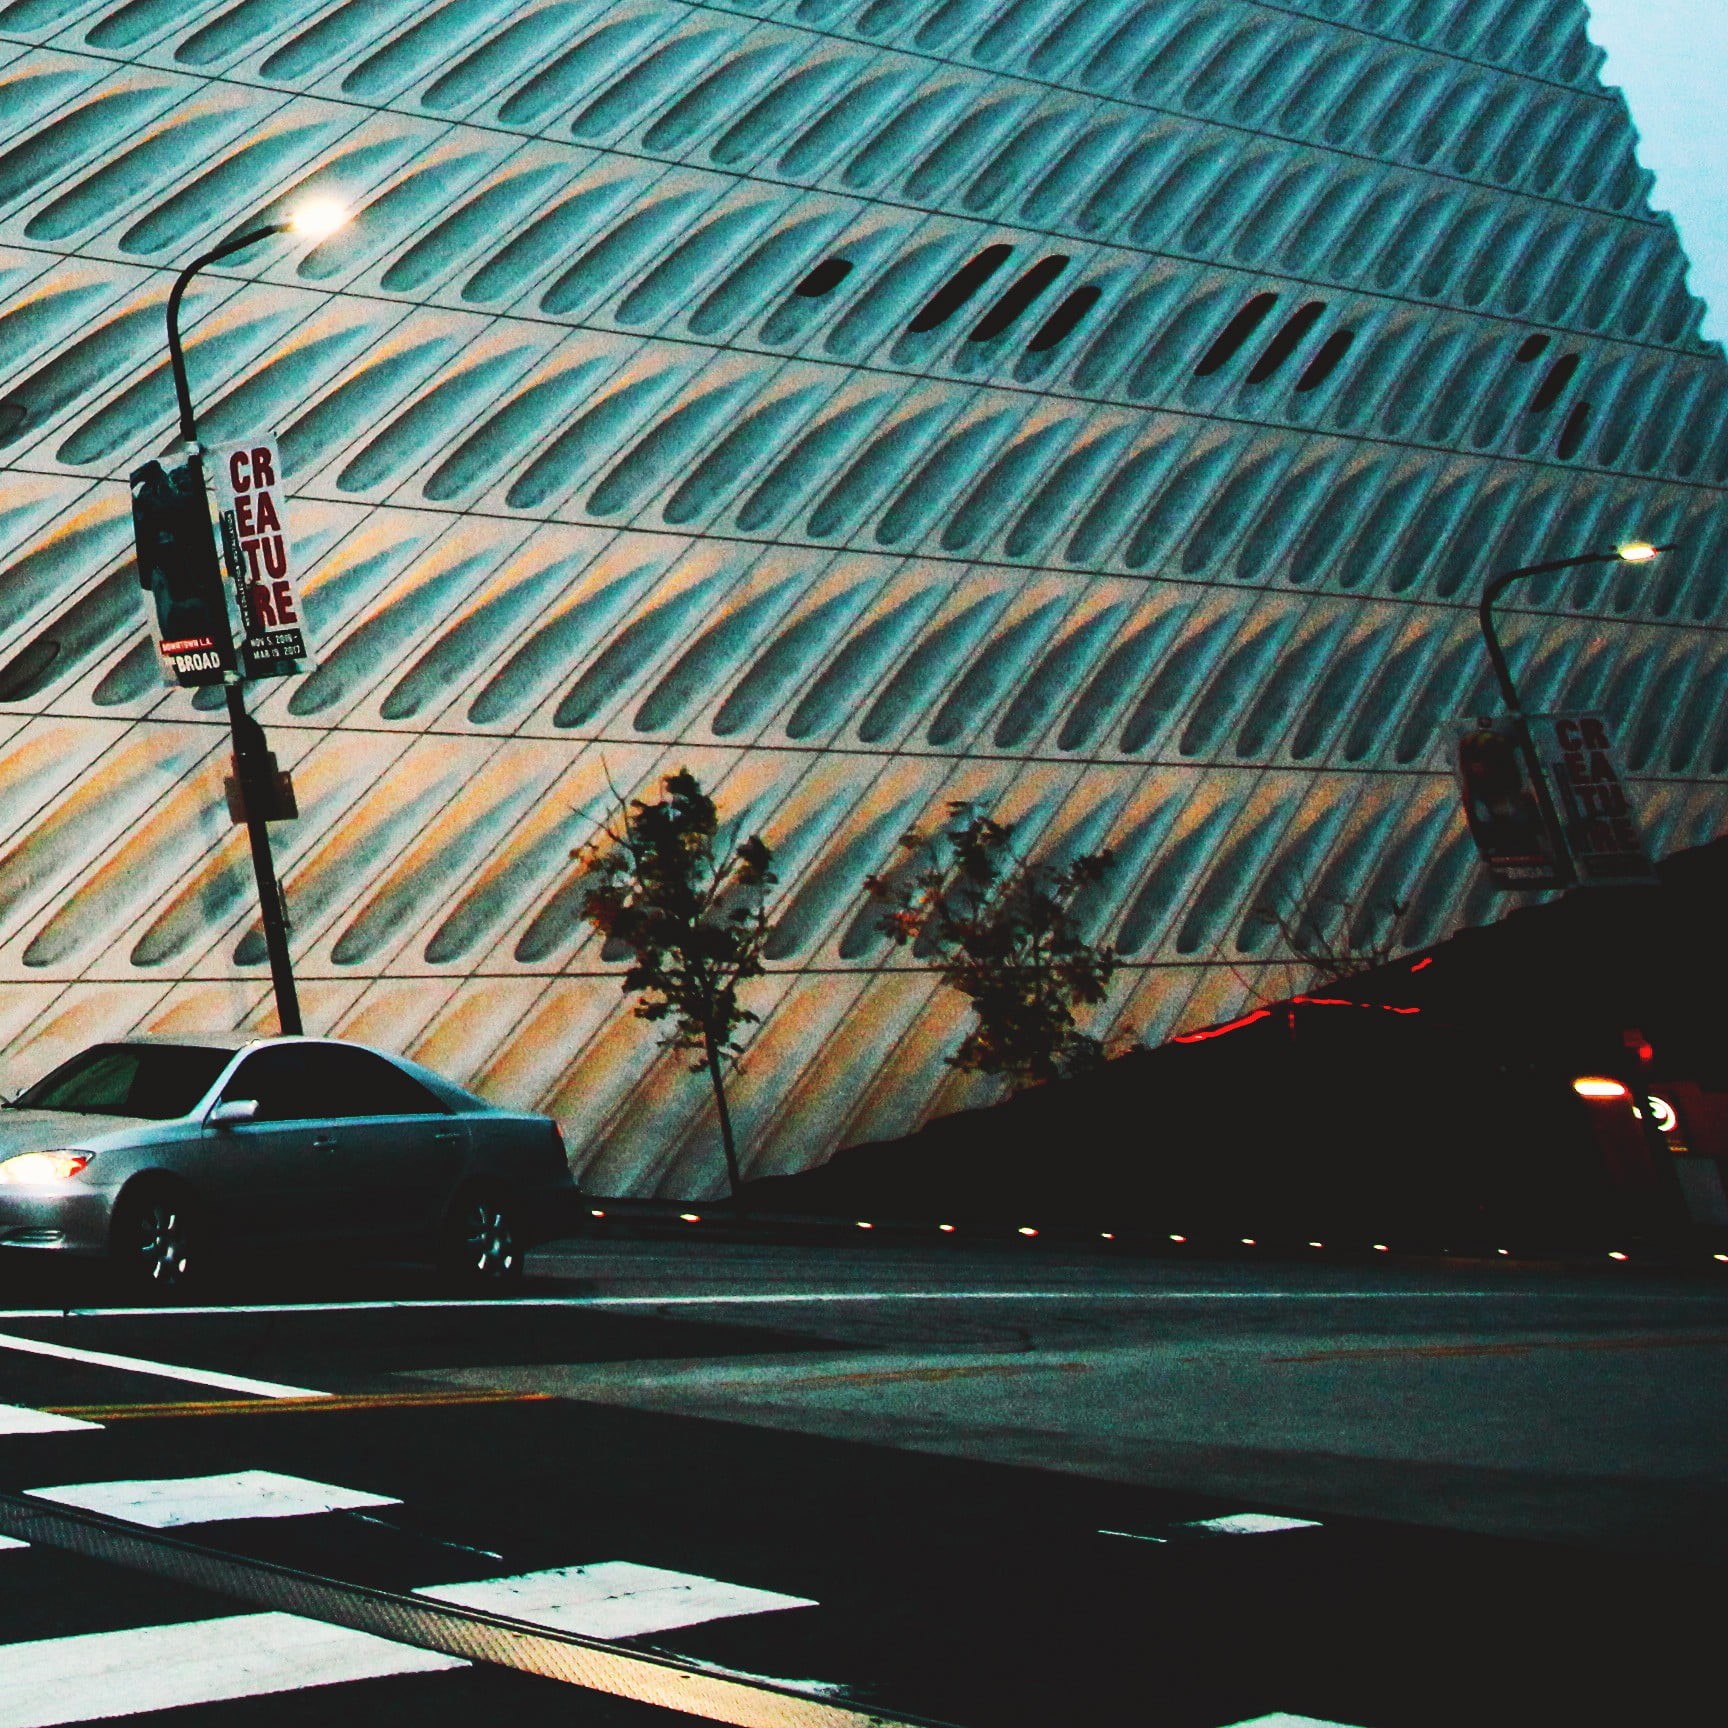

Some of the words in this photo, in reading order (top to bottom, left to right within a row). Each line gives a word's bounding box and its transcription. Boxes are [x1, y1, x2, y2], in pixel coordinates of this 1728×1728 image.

[230, 447, 275, 493] CR
[234, 491, 281, 538] EA
[241, 534, 288, 582] TU
[252, 580, 297, 627] RE
[176, 651, 221, 673] BROAD
